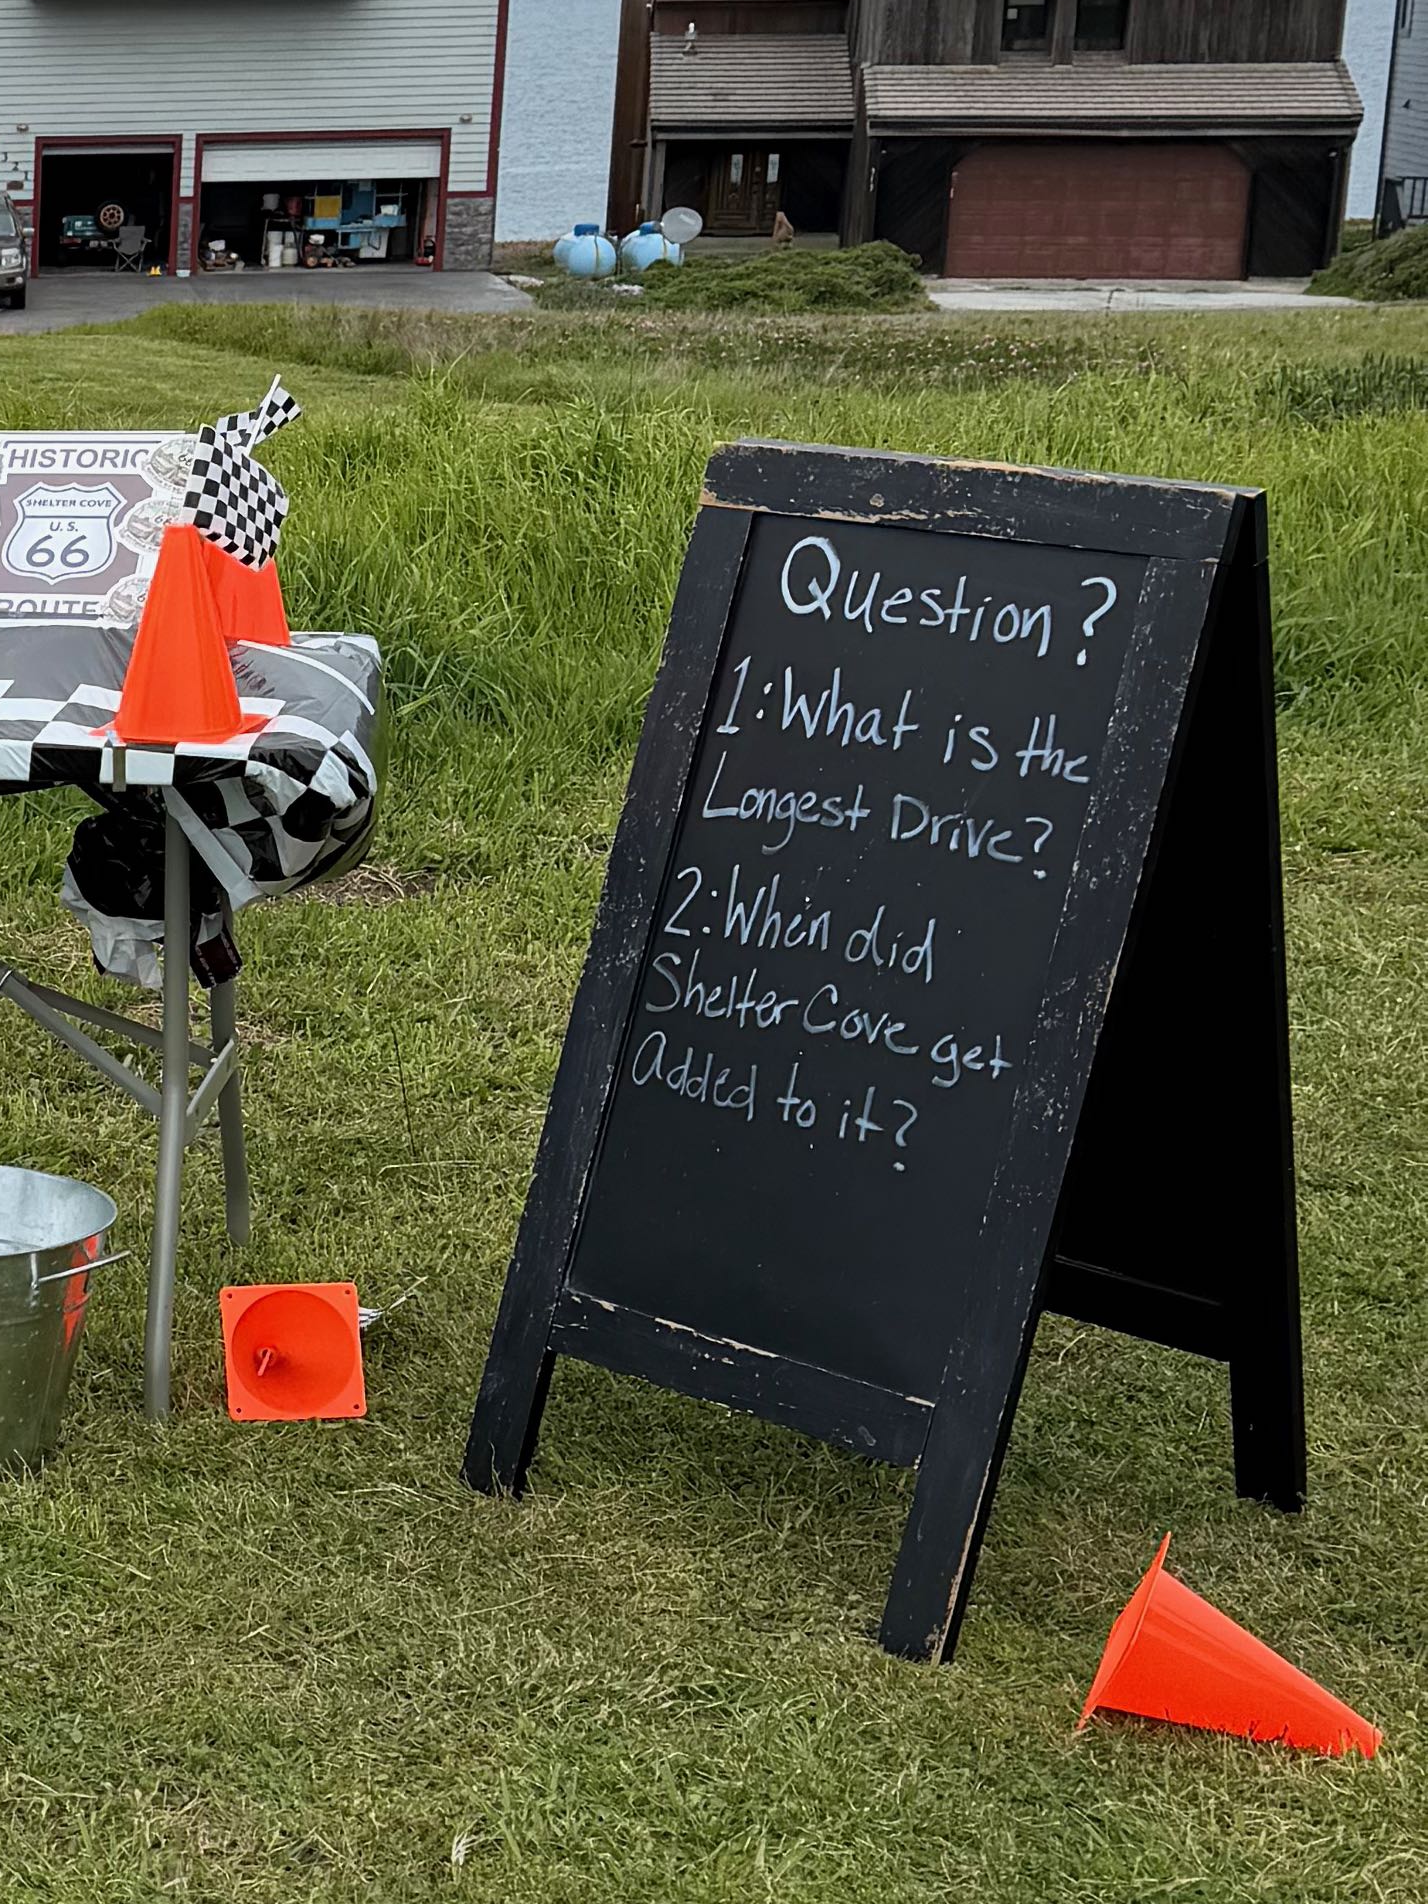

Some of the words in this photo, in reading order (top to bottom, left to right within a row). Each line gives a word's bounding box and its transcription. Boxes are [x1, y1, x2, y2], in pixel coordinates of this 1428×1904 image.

[25, 498, 76, 507] SHELTER
[80, 498, 111, 507] COVE
[26, 534, 89, 568] 66
[781, 536, 1050, 657] Question
[944, 716, 998, 771] is
[1016, 715, 1089, 784] the
[703, 751, 871, 854] Longest
[891, 795, 1054, 879] Drive?
[846, 906, 933, 983] did
[645, 948, 800, 1028] Shelter
[803, 985, 919, 1054] Cove
[930, 1034, 1012, 1088] get
[777, 1062, 816, 1128] to
[838, 1086, 917, 1172] it?
